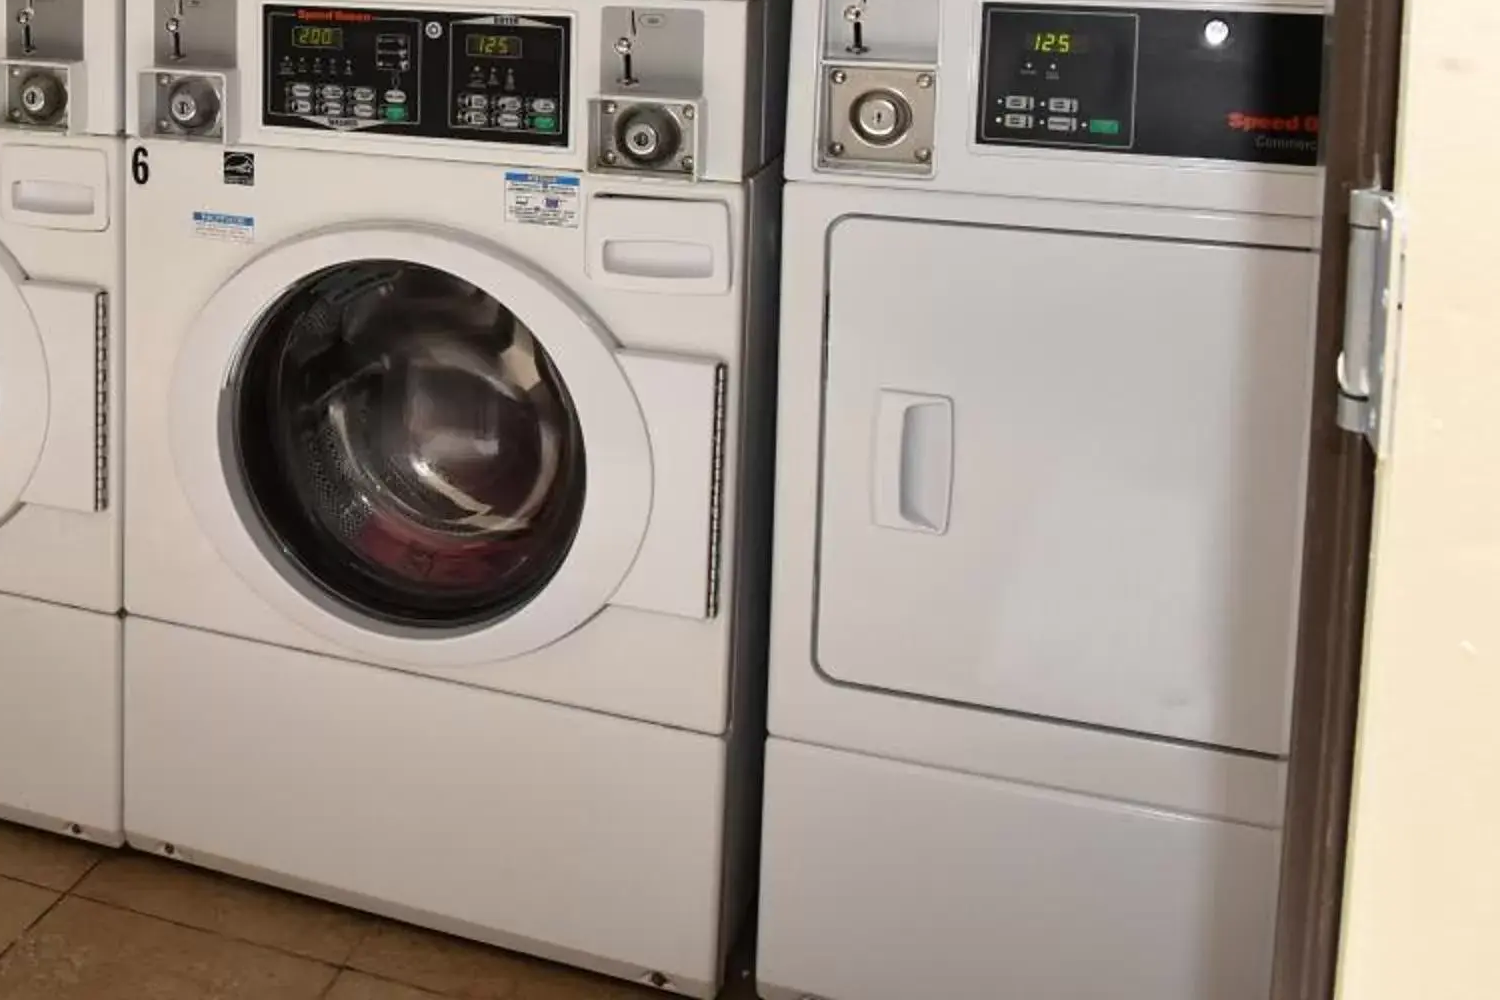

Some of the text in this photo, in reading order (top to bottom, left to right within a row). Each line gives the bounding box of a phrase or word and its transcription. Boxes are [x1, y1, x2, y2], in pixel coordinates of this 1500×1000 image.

[296, 8, 333, 21] Speed
[300, 27, 333, 45] 200
[479, 36, 509, 54] 125
[1034, 32, 1071, 53] 125
[1227, 111, 1300, 132] Speed
[131, 146, 150, 185] 6
